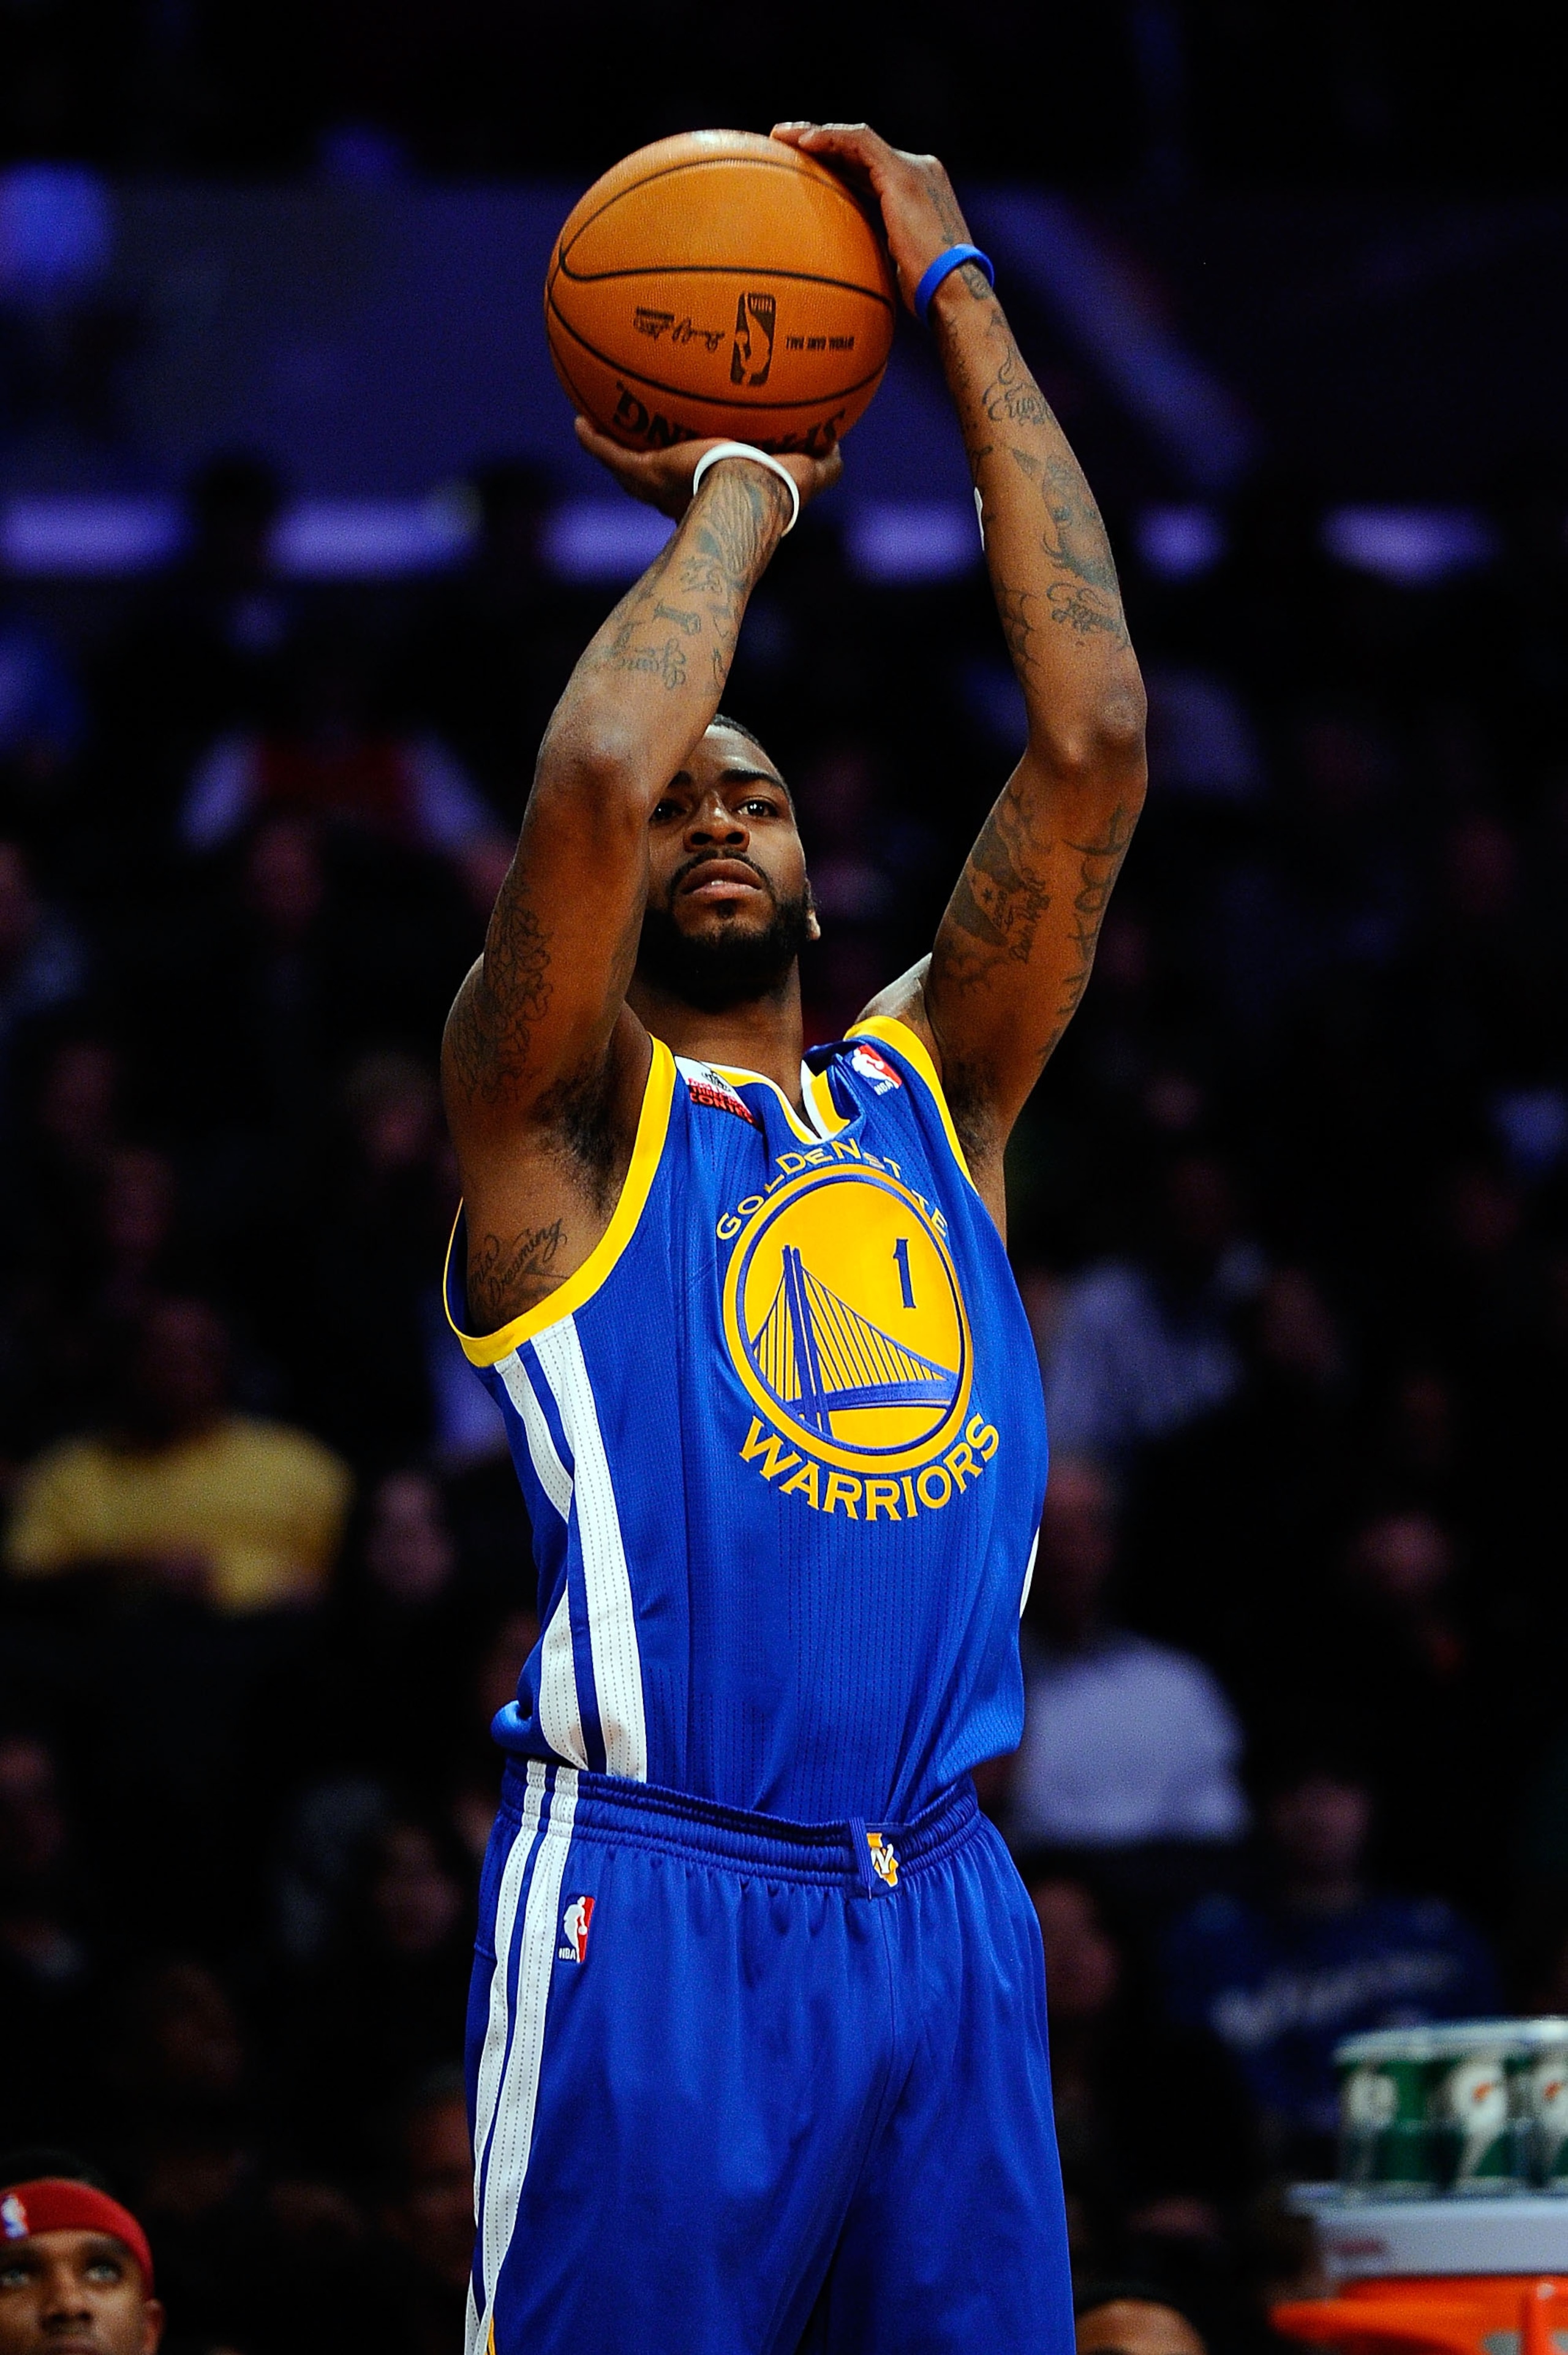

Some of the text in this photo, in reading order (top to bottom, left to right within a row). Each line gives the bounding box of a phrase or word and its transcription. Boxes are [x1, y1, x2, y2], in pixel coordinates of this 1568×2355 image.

[873, 1079, 894, 1095] NBA
[716, 1138, 948, 1240] GOLDEN STTE
[893, 1238, 917, 1309] 1
[739, 1413, 1000, 1521] WARRIORS
[559, 1948, 576, 1960] NBA
